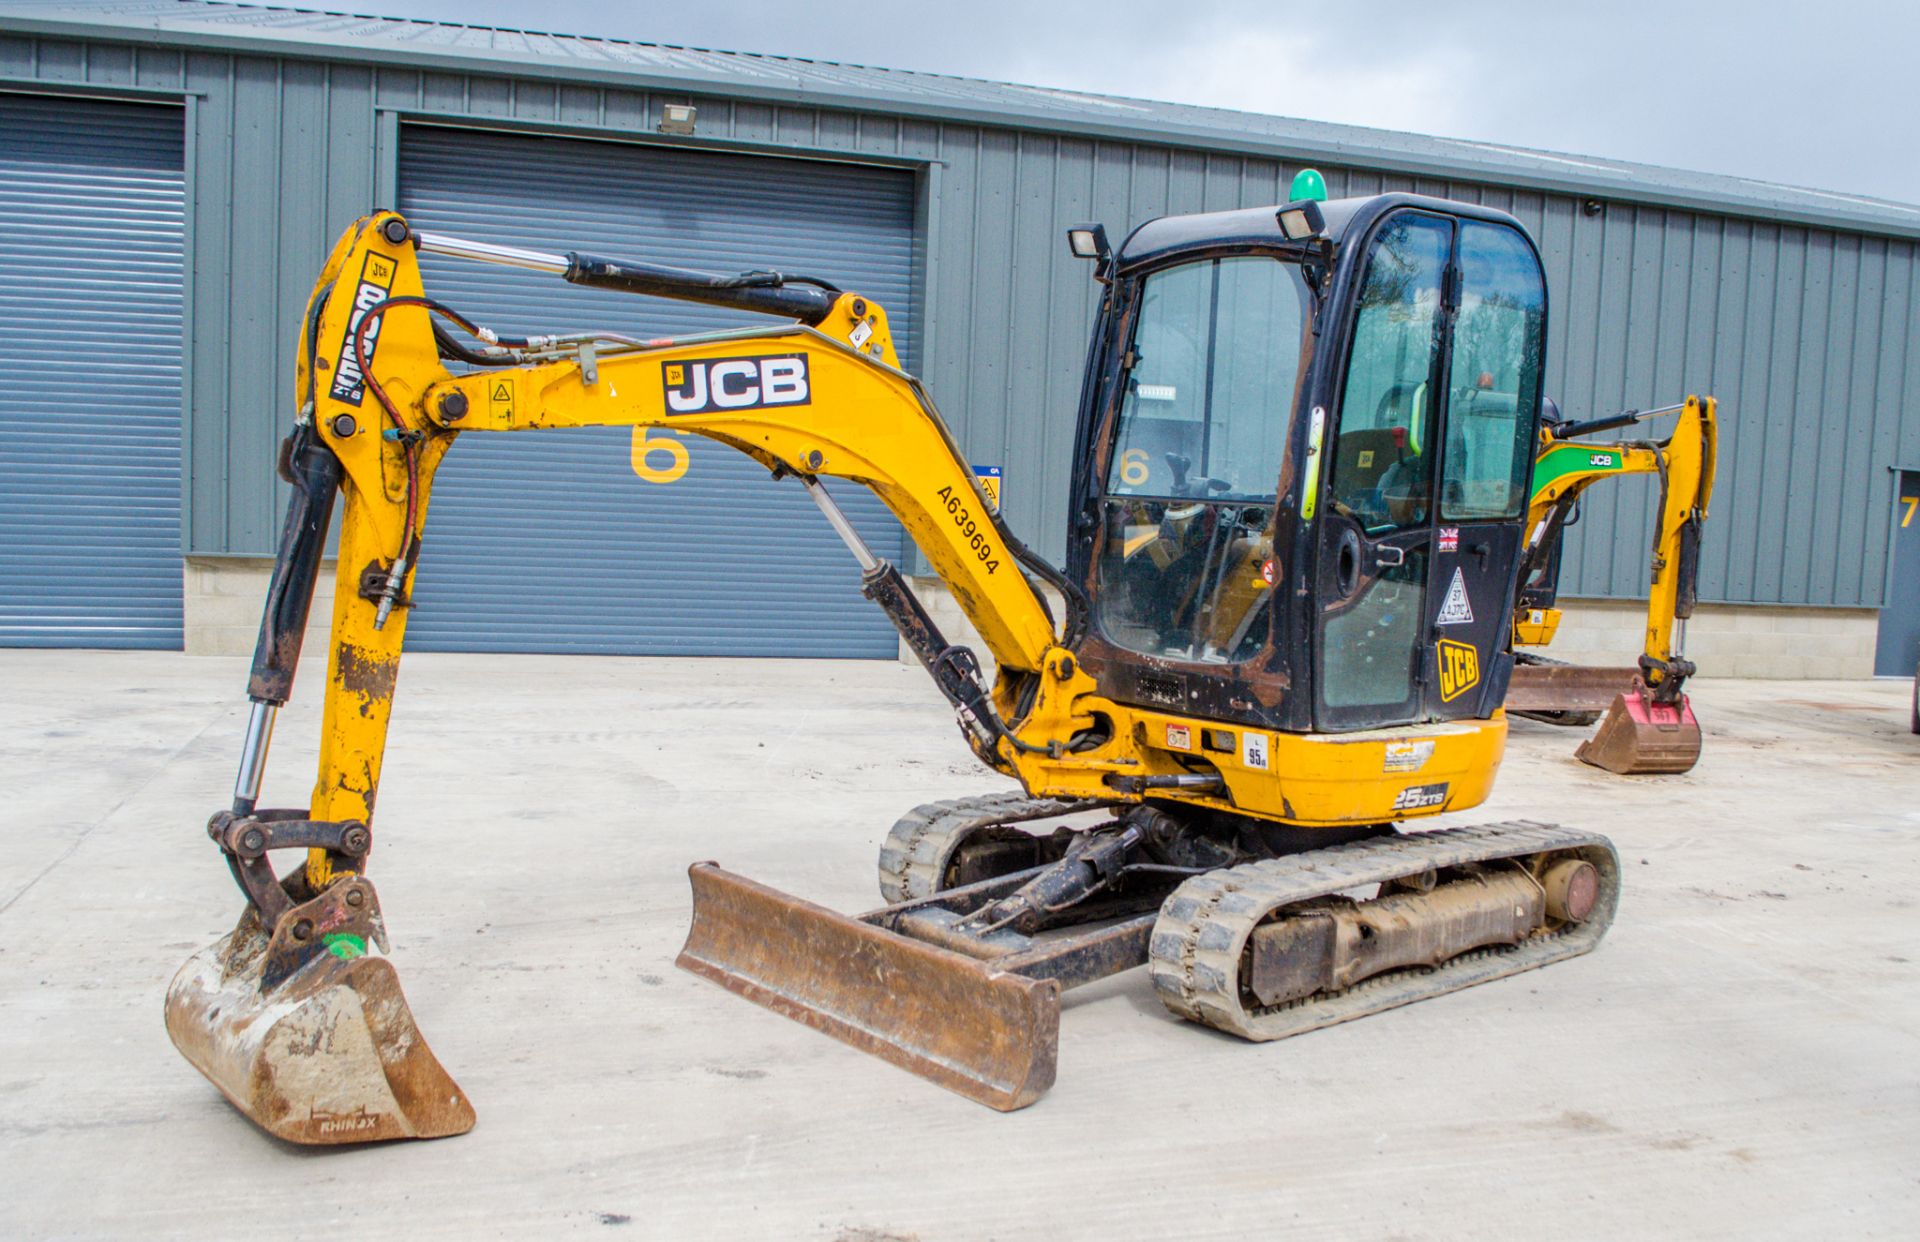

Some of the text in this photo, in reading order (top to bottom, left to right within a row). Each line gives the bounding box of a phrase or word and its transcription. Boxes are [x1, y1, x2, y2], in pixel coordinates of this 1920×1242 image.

[667, 358, 809, 412] JCB
[631, 424, 690, 484] 6
[1120, 448, 1149, 486] 6
[1590, 455, 1612, 466] JCB
[937, 485, 999, 574] A639694
[1901, 496, 1920, 528] 7
[1443, 646, 1476, 695] JCB
